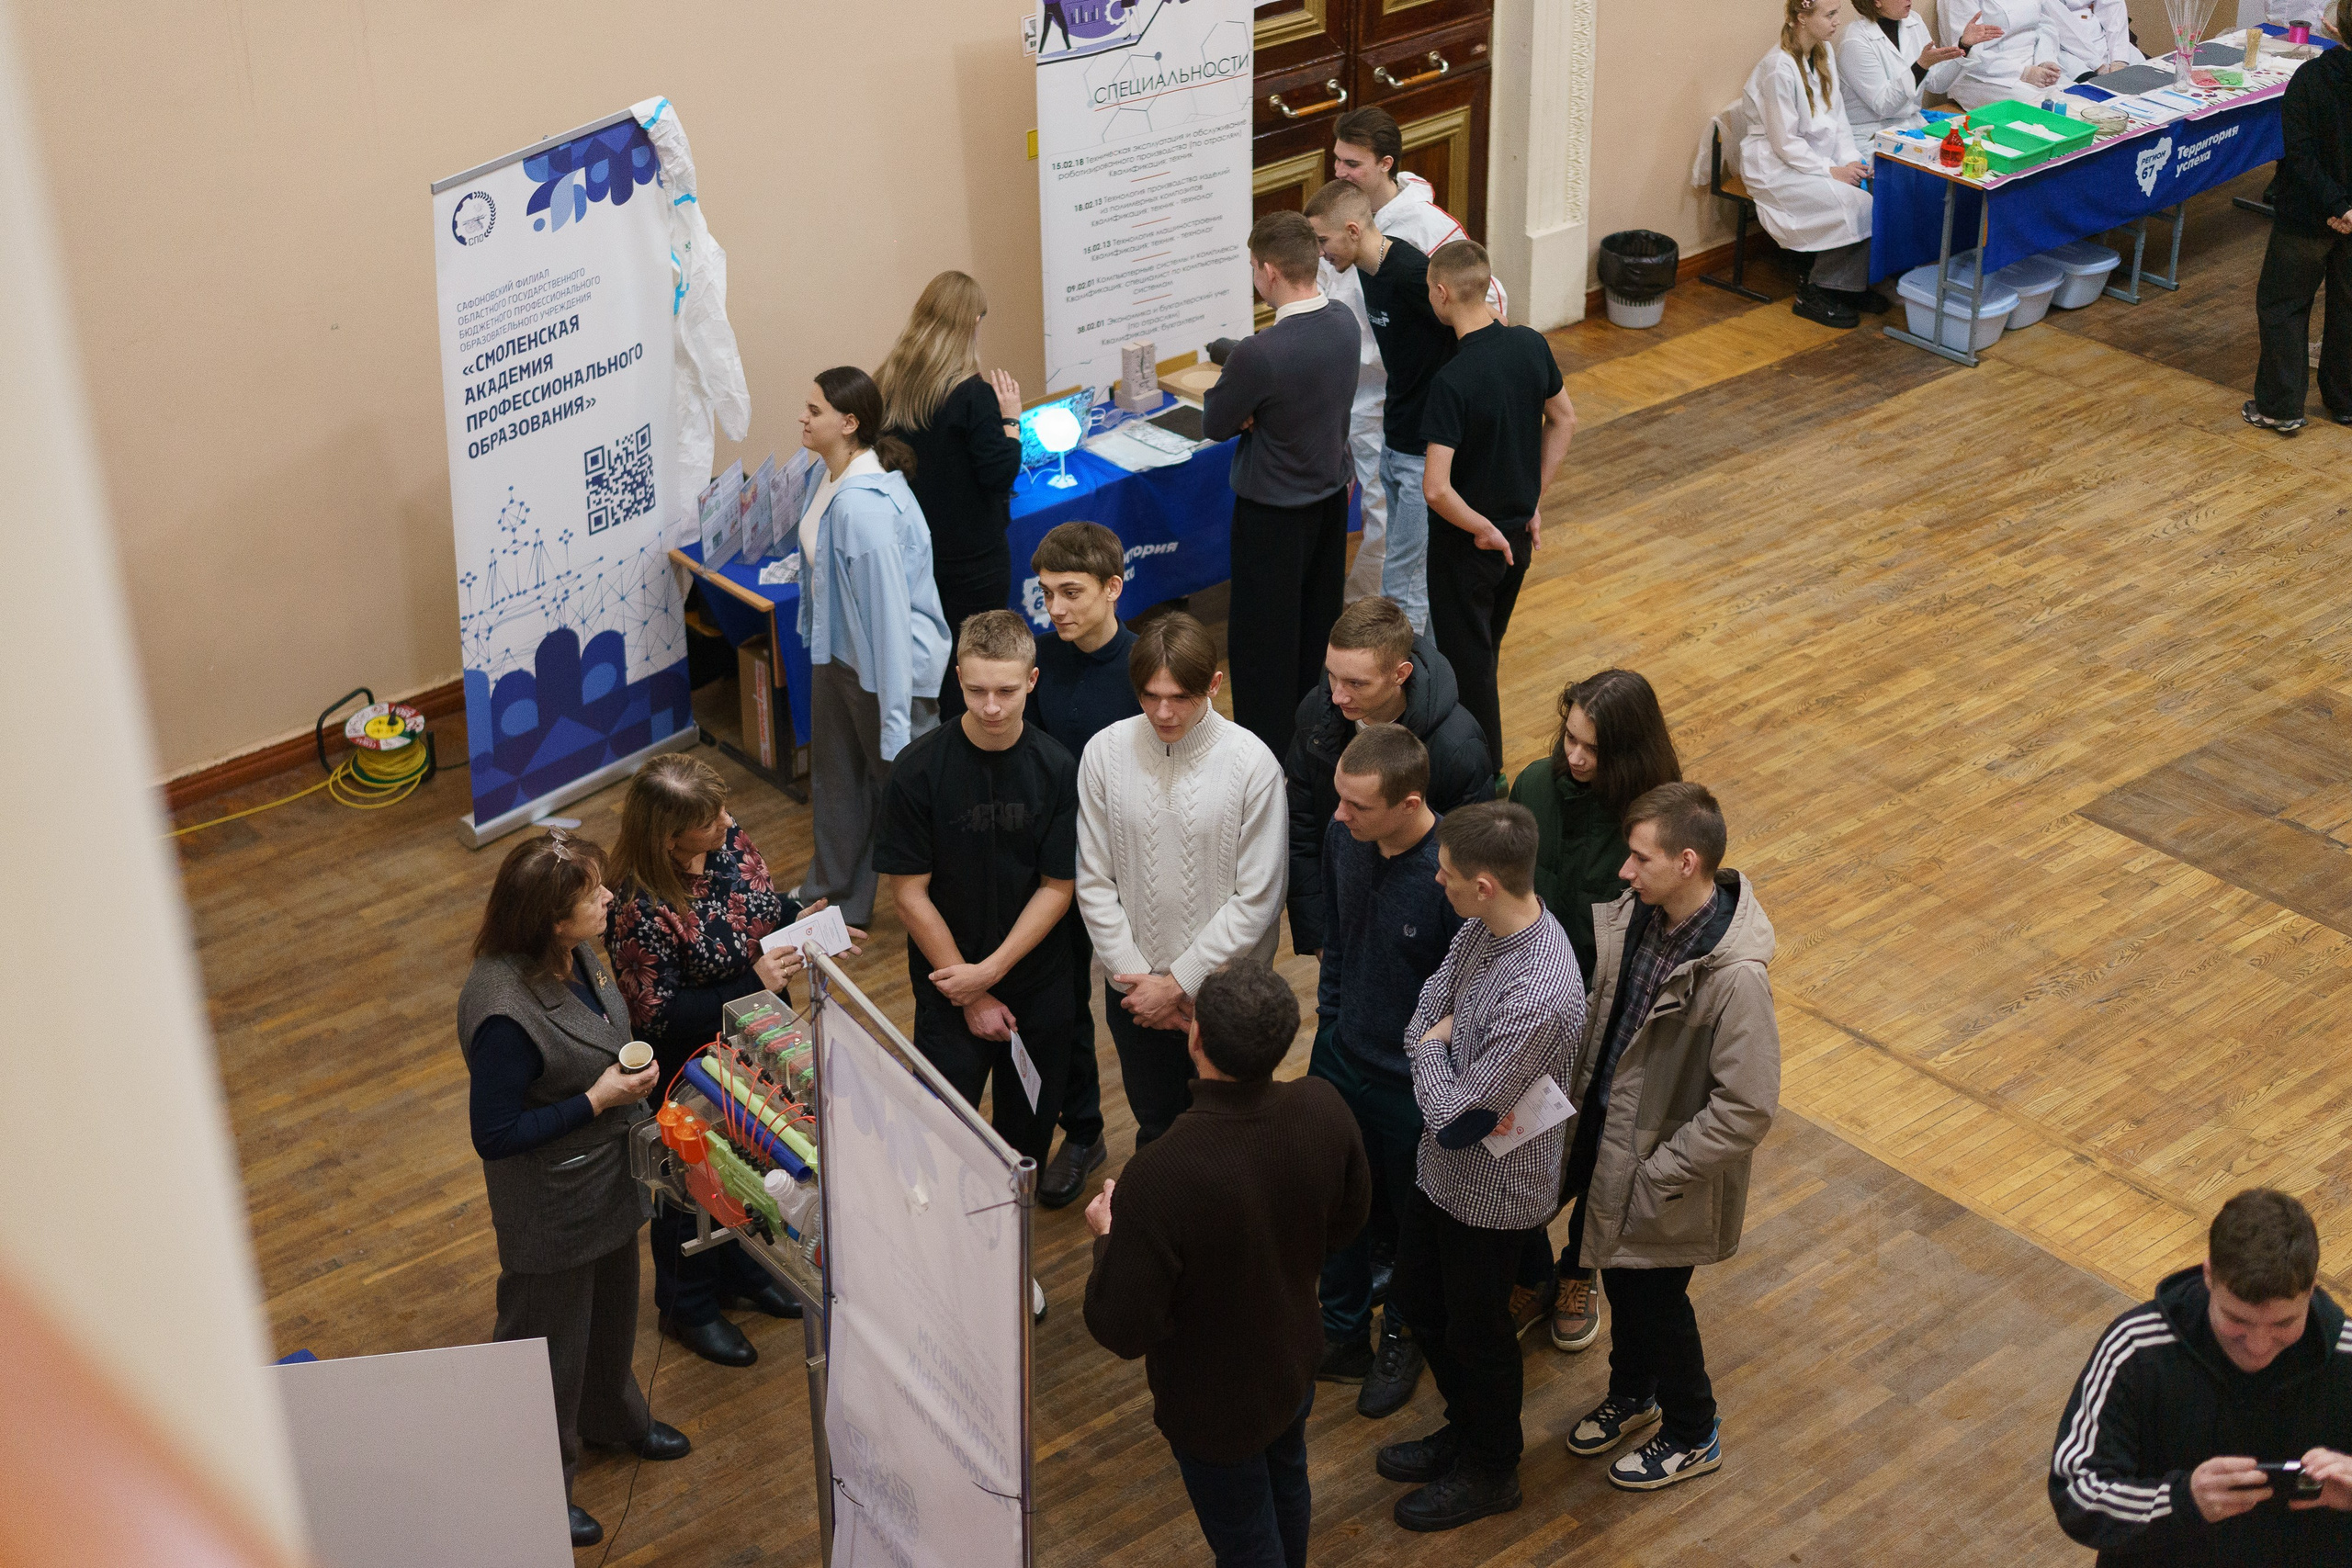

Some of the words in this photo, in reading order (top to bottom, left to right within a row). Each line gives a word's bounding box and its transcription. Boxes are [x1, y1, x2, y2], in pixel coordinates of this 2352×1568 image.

[1094, 53, 1250, 104] СПЕЦИАЛЬНОСТИ
[1051, 158, 1084, 171] 15.02.18
[1086, 147, 1131, 164] Техническая
[1133, 134, 1184, 152] эксплуатация
[1193, 118, 1247, 137] обслуживание
[1058, 156, 1135, 180] роботизированного
[1136, 143, 1187, 161] производства
[1169, 152, 1193, 163] техник
[2141, 150, 2166, 165] РЕГИОН
[2177, 125, 2240, 160] Территория
[2142, 164, 2155, 180] 67
[2175, 150, 2211, 178] успеха
[1074, 197, 1102, 212] 18.02.13
[1103, 188, 1146, 203] Технология
[1148, 176, 1198, 193] производства
[1199, 166, 1230, 181] изделий
[1110, 197, 1159, 212] полимерных
[1159, 185, 1204, 200] композитов
[1150, 200, 1174, 212] техник
[1181, 192, 1214, 205] технолог
[468, 233, 484, 246] СПО
[1083, 241, 1112, 254] 15.02.13
[1113, 231, 1154, 246] Технология
[1156, 214, 1223, 235] машиностроения
[1151, 235, 1175, 247] техник
[1181, 226, 1214, 240] технолог
[1067, 278, 1095, 294] 09.02.01
[1096, 265, 1154, 284] Компьютерные
[1156, 256, 1189, 270] системы
[1196, 243, 1239, 259] комплексы
[1125, 271, 1170, 288] специалист
[1171, 267, 1182, 276] по
[1182, 254, 1239, 272] компьютерным
[1133, 279, 1174, 295] системам
[457, 280, 514, 312] САФОНОВСКИЙ
[515, 268, 549, 289] ФИЛИАЛ
[458, 298, 506, 326] ОБЛАСТНОГО
[508, 267, 585, 305] ГОСУДАРСТВЕННОГО
[459, 309, 513, 340] БЮДЖЕТНОГО
[514, 275, 601, 316] ПРОФЕССИОНАЛЬНОГО
[459, 313, 539, 353] ОБРАЗОВАТЕЛЬНОГО
[539, 291, 592, 321] УЧРЕЖДЕНИЯ
[1077, 320, 1104, 334] 38.02.01
[1107, 309, 1151, 326] Экономика
[1159, 291, 1213, 312] бухгалтерский
[462, 313, 580, 376] «СМОЛЕНСКАЯ
[464, 353, 553, 405] АКАДЕМИЯ
[466, 342, 643, 434] ПРОФЕССИОНАЛЬНОГО
[468, 395, 596, 459] ОБРАЗОВАНИЯ»
